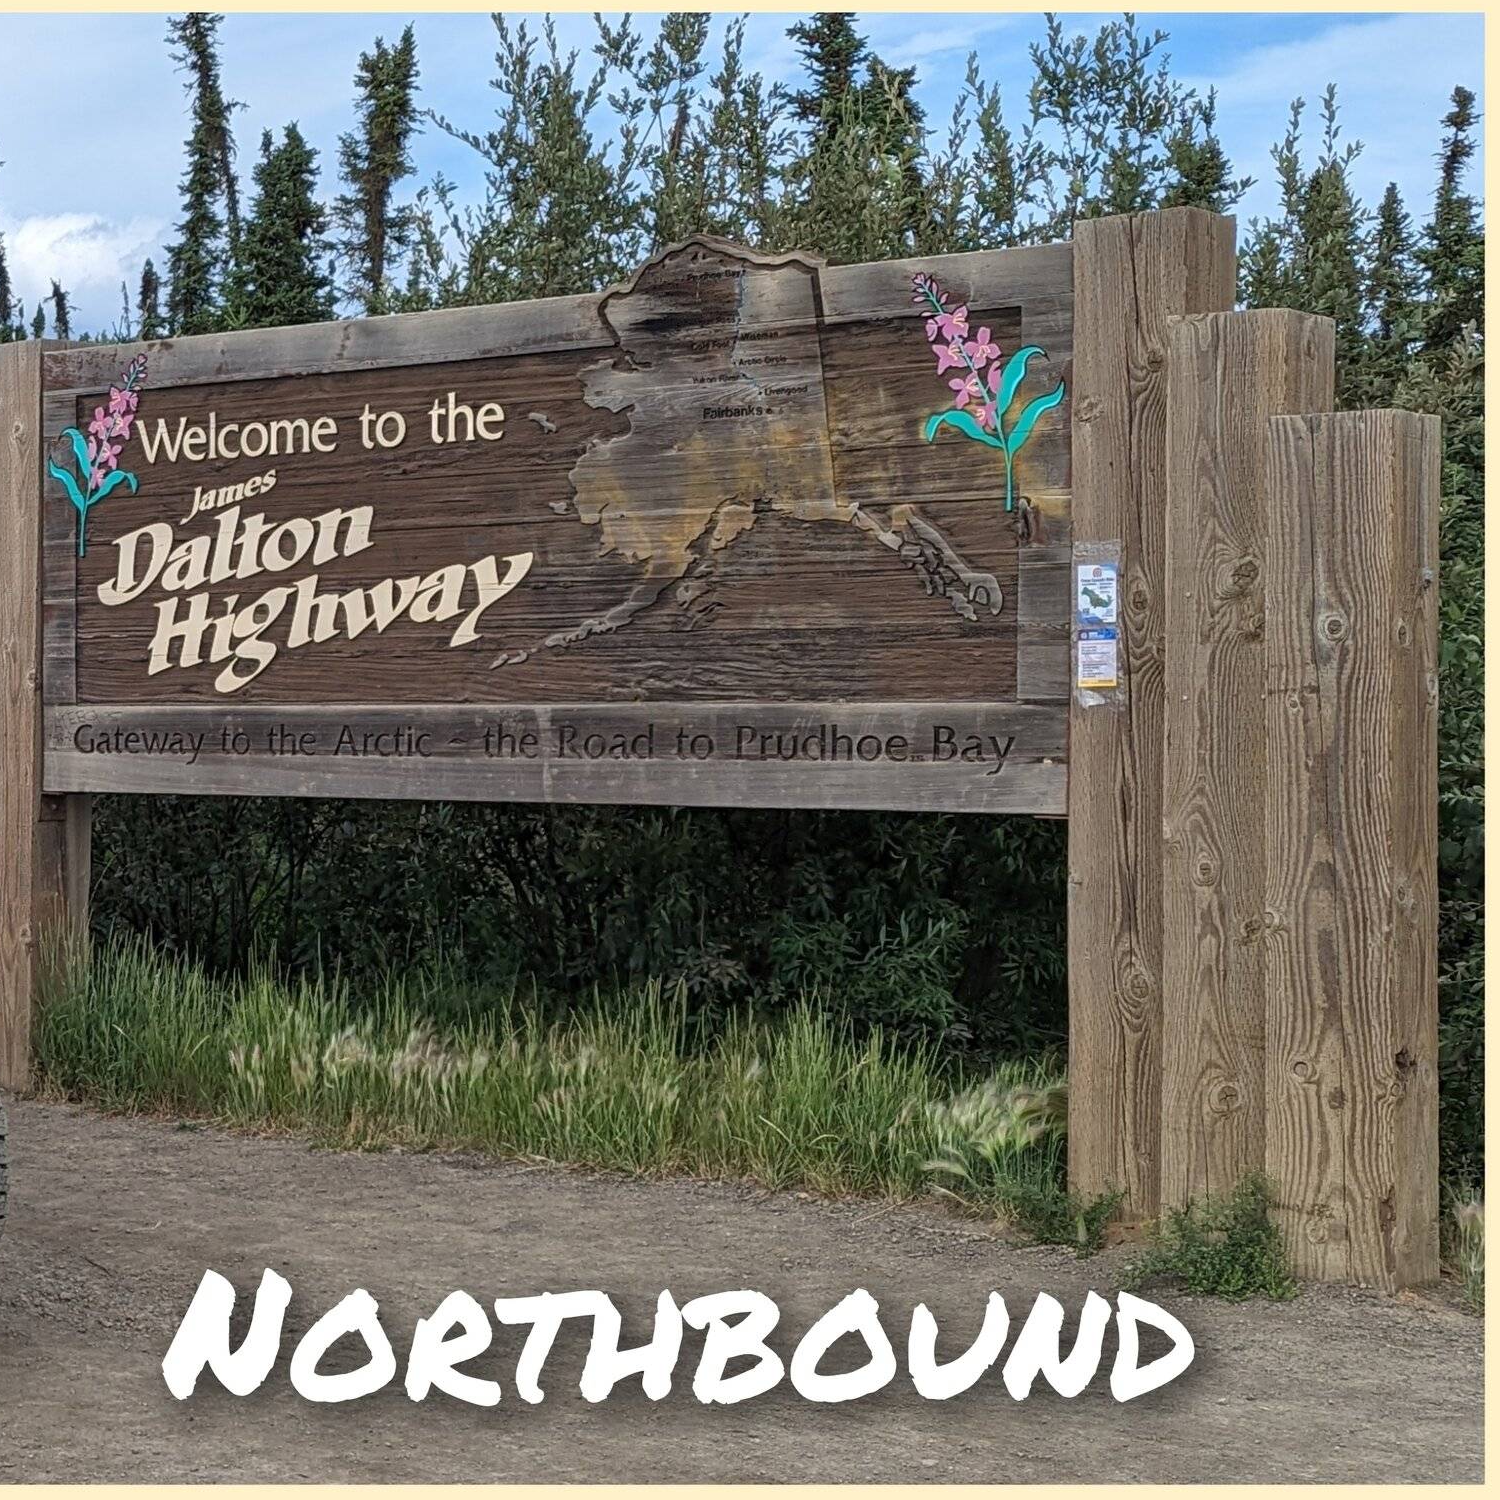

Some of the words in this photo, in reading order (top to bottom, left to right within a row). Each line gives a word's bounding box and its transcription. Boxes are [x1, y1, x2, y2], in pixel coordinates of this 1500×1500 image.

[136, 411, 338, 465] Welcome
[359, 403, 406, 449] to
[428, 391, 505, 444] the
[703, 404, 763, 419] Fairbanks
[182, 469, 277, 524] James
[97, 505, 374, 606] Dalton
[147, 551, 534, 693] Highway
[74, 723, 205, 765] Gateway
[220, 725, 251, 756] to
[267, 724, 317, 756] the
[334, 724, 432, 757] Arctic
[484, 724, 540, 759] the
[557, 723, 655, 761] Road
[676, 726, 715, 762] to
[735, 722, 910, 762] Prudhoe
[932, 724, 1016, 776] Bay
